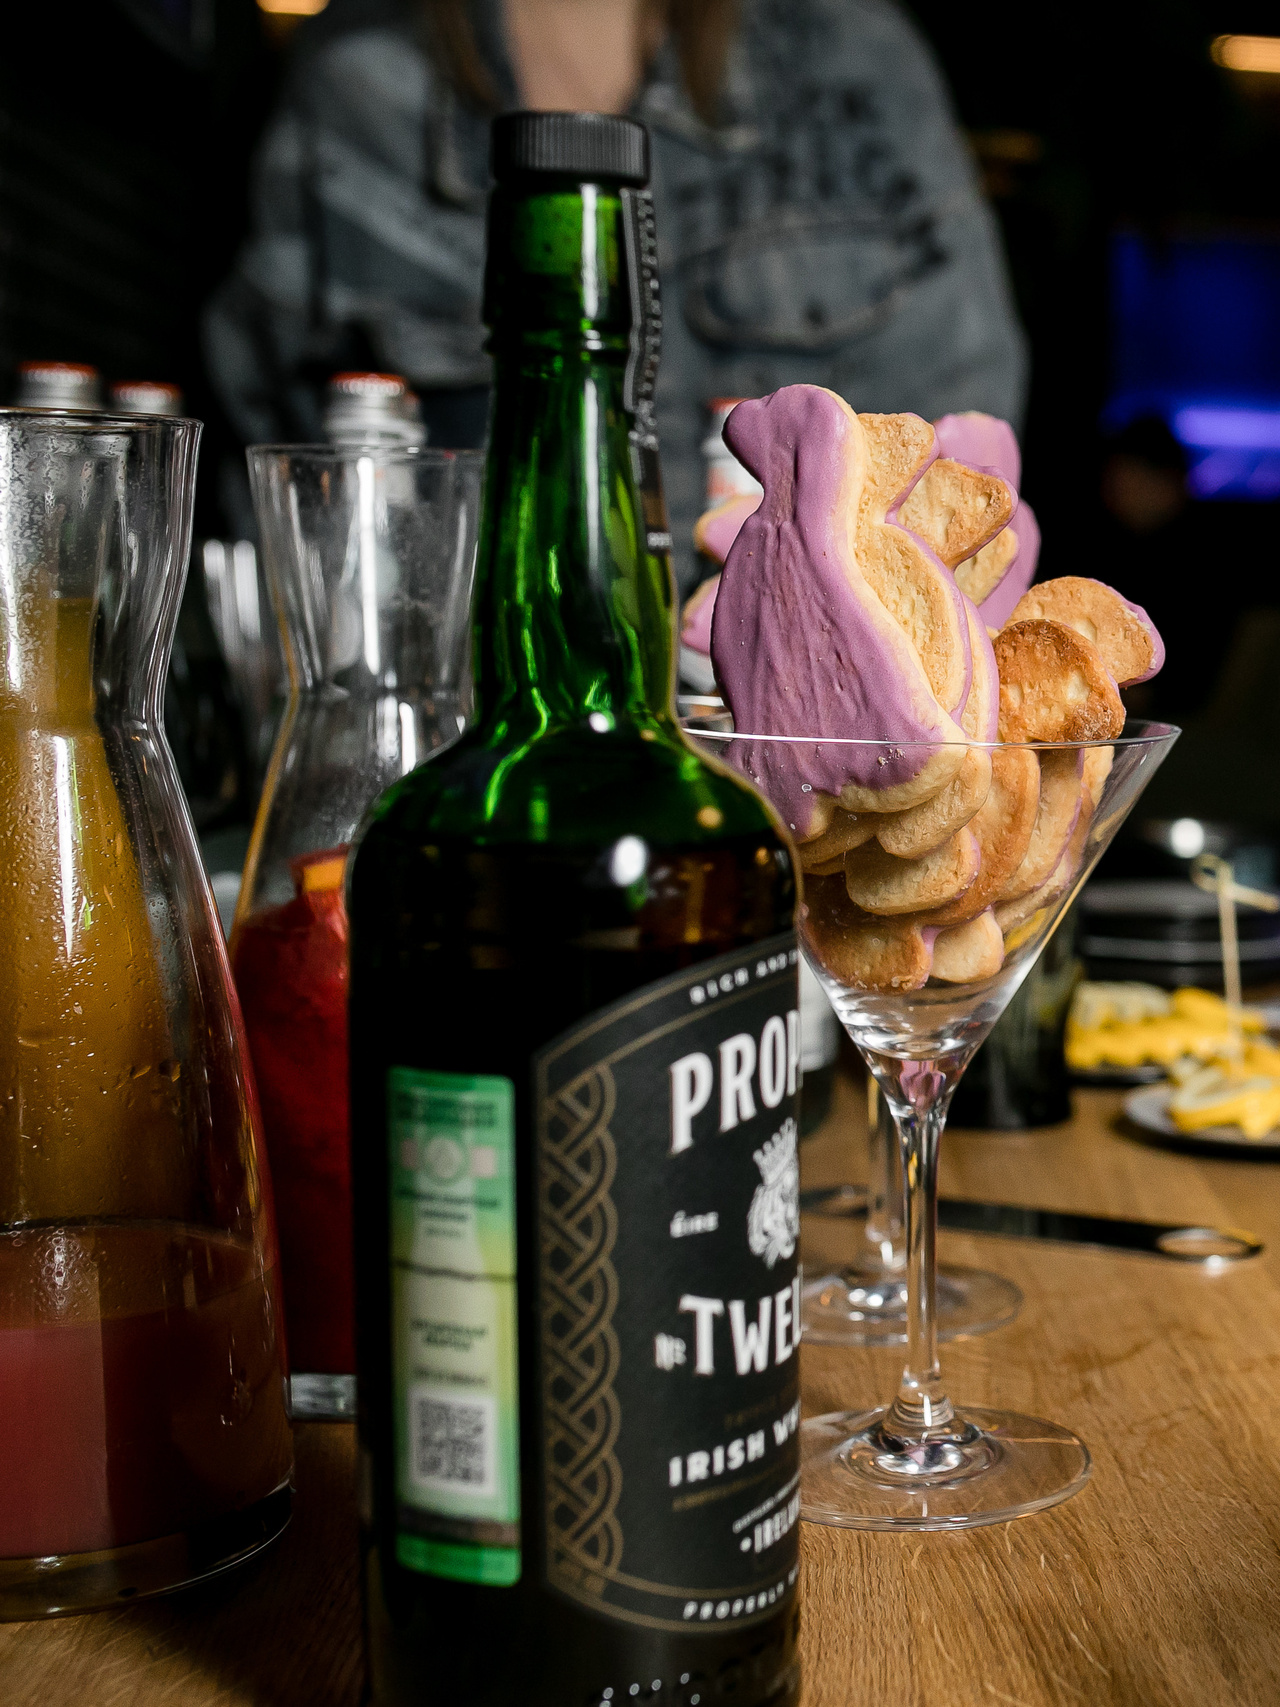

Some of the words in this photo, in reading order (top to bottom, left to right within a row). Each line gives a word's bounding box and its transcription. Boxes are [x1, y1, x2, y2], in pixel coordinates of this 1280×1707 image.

[670, 1009, 802, 1155] PROP
[678, 1272, 802, 1375] TWEL
[669, 1429, 765, 1487] IRISH
[772, 1400, 800, 1446] WH
